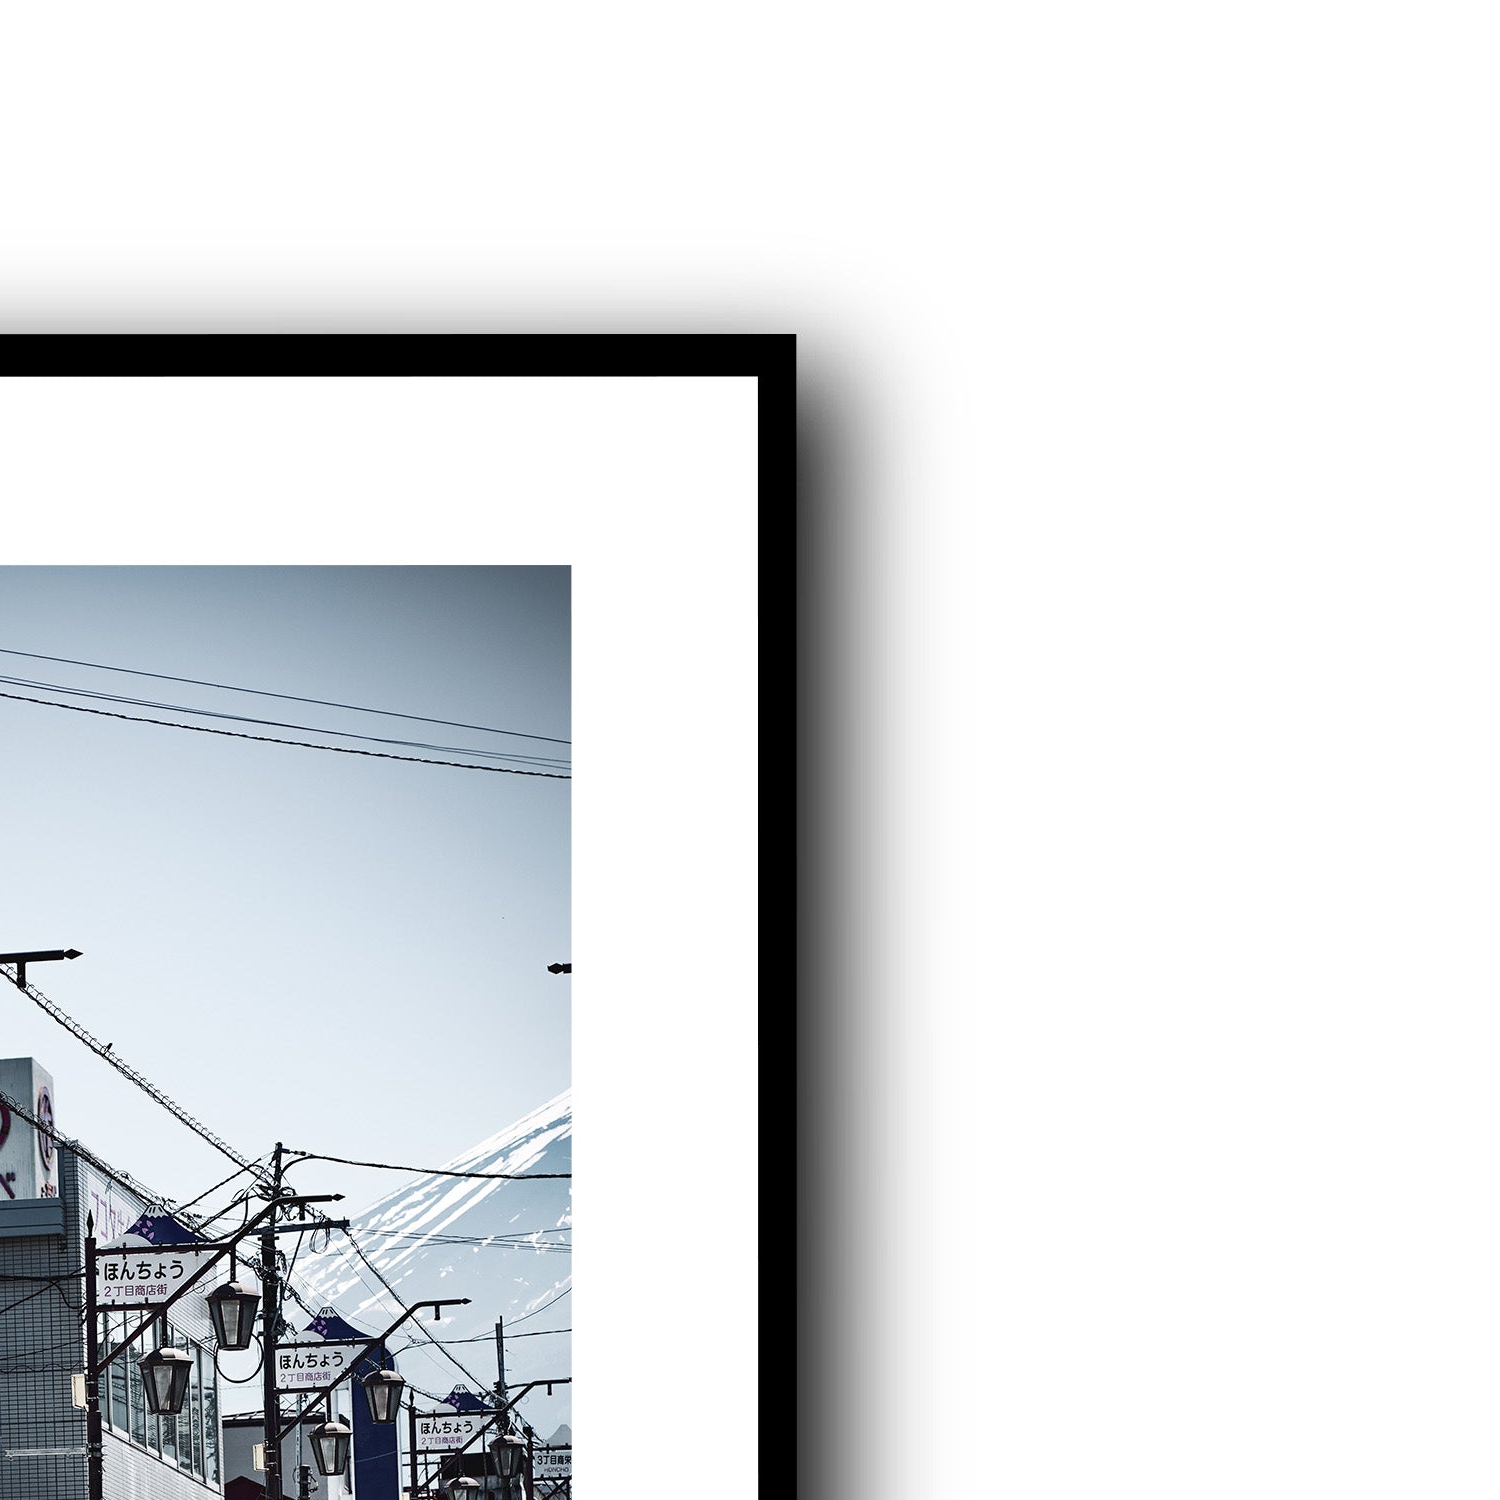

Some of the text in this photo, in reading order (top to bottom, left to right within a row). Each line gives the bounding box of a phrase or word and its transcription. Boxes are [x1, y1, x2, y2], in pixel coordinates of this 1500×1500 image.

[103, 1260, 184, 1281] ほんちょう
[104, 1283, 167, 1297] 2丁目商店街
[280, 1351, 344, 1370] ほんちょう
[280, 1371, 331, 1383] 2丁目商店街
[420, 1420, 474, 1435] ほんちょう
